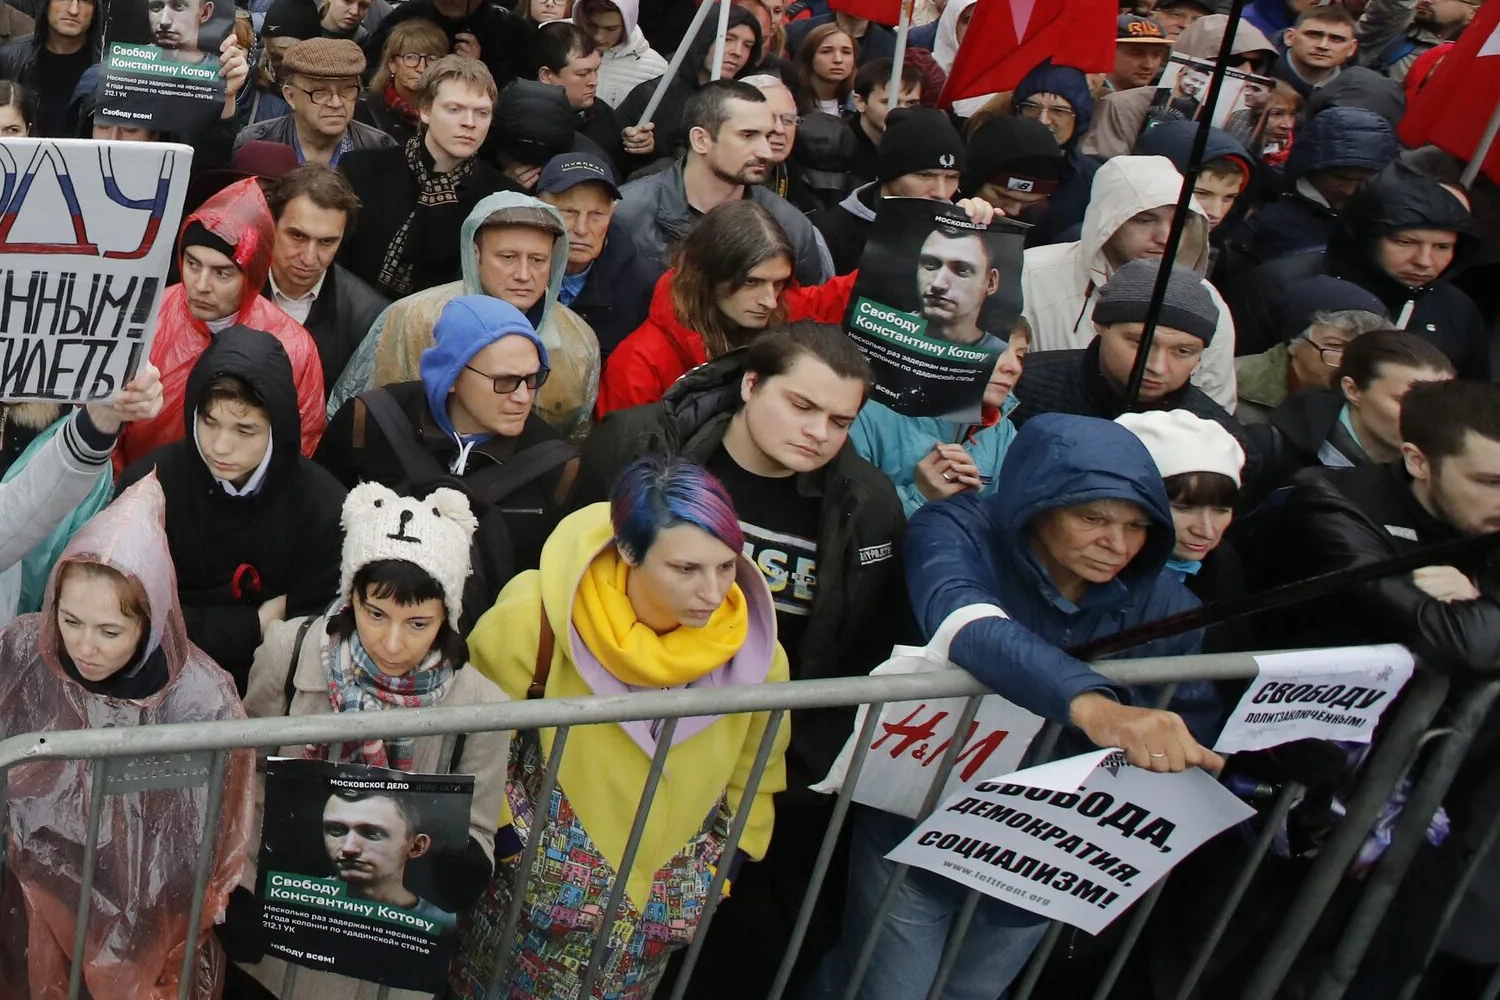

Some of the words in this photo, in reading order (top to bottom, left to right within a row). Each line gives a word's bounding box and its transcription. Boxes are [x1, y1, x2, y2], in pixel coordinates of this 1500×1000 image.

[113, 46, 157, 60] Свободу
[112, 58, 178, 76] Константину
[181, 67, 215, 80] Котову
[106, 74, 137, 84] Несколько
[149, 79, 176, 89] задержан
[125, 85, 149, 93] колонии
[195, 92, 214, 100] статье
[102, 107, 131, 119] Свободу
[132, 111, 152, 120] всем!
[935, 215, 975, 229] МОСКОВС
[860, 302, 921, 334] Свободу
[855, 315, 946, 356] Константину
[948, 345, 988, 362] Котову
[848, 331, 886, 352] Несколько
[887, 349, 901, 359] раз
[901, 354, 939, 370] задержан
[869, 350, 900, 368] колонии
[901, 364, 911, 373] по
[1252, 682, 1386, 710] СВОБОДУ
[1244, 709, 1367, 728] ПОЛИТЗАКЛЮЧЁННЫМ!
[870, 703, 1011, 783] H&M
[330, 778, 385, 789] МОСКОВСКОЕ
[386, 782, 409, 790] ДЕЛО
[946, 797, 1141, 887] ДЕМОКРАТИЯ,
[917, 830, 1120, 909] СОЦИАЛИЗМ!
[272, 875, 340, 896] Свободу
[943, 859, 1050, 906] www.leftfront.org
[270, 887, 373, 916] Константину
[377, 906, 435, 932] Котову
[263, 920, 281, 931] 212.1
[283, 924, 296, 933] УК
[263, 912, 268, 920] 4
[270, 914, 290, 924] года
[291, 919, 328, 931] колонии
[330, 926, 341, 934] по
[342, 929, 399, 946] «дадинской»
[401, 942, 430, 955] статье
[264, 905, 310, 918] Несколько
[311, 914, 327, 923] раз
[328, 916, 371, 932] задержан
[385, 929, 428, 945] несанкце
[271, 942, 304, 958] ободу
[306, 952, 335, 964] всем!
